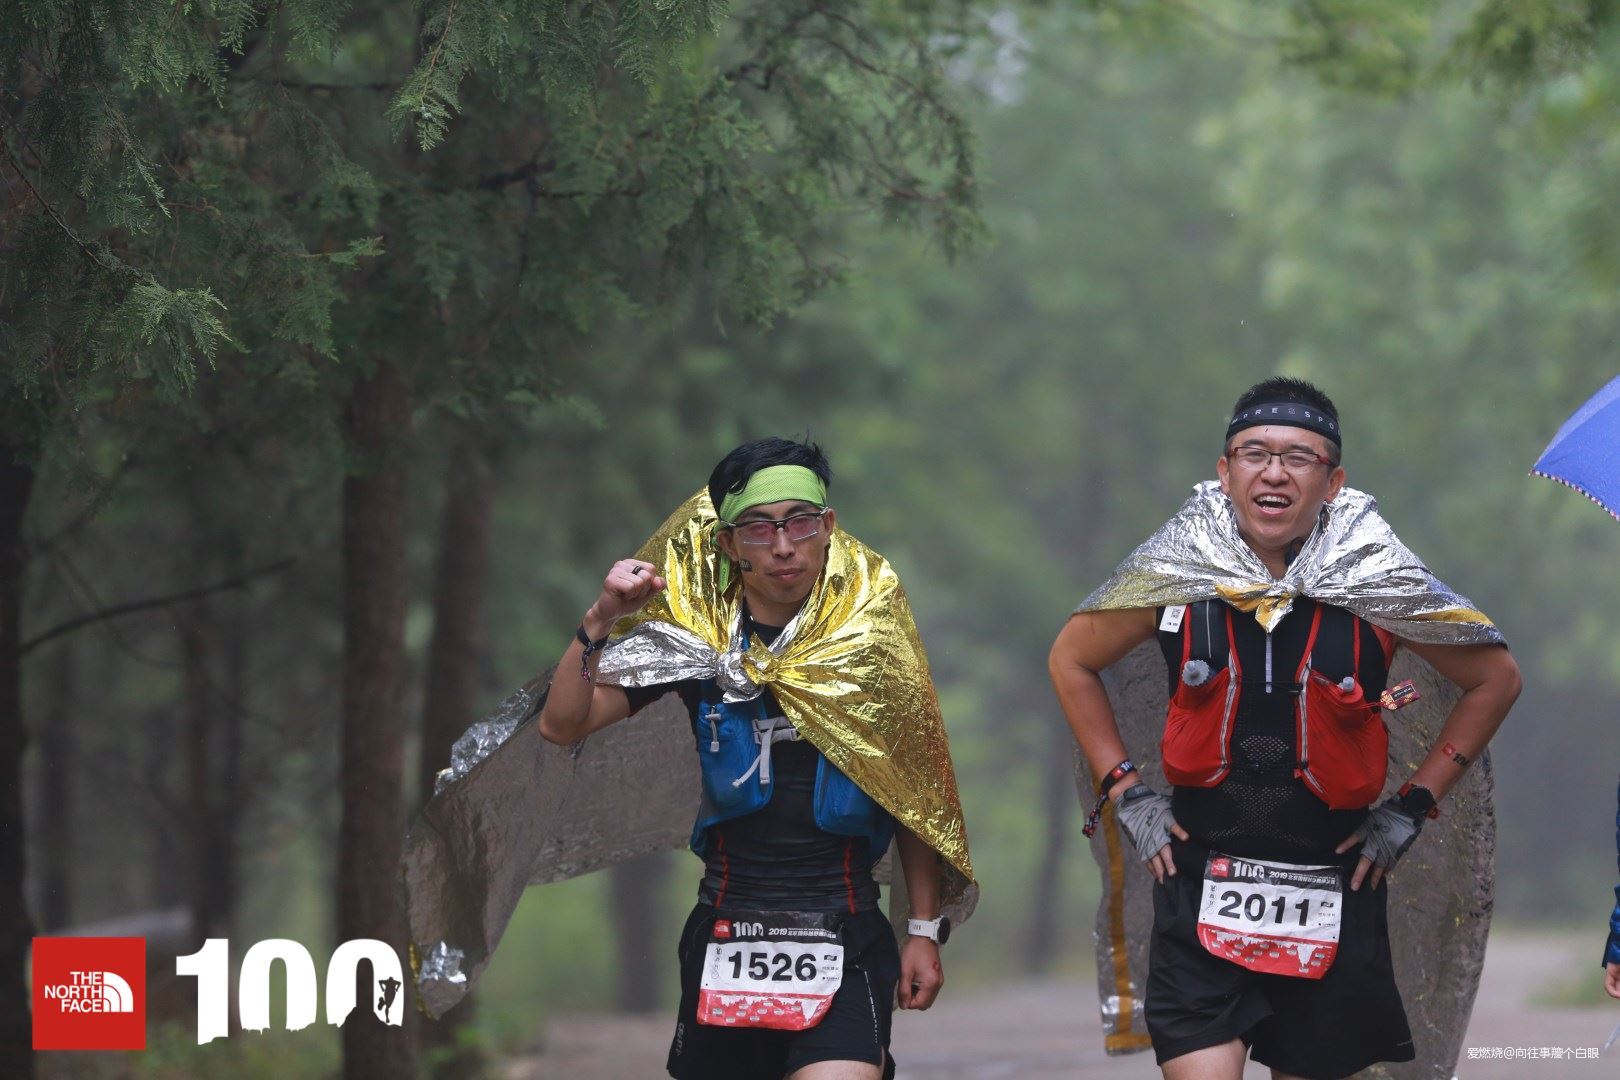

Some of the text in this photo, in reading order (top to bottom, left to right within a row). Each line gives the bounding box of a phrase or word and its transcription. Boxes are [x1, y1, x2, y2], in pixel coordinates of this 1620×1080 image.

[1232, 861, 1265, 879] 100
[1269, 870, 1288, 879] 2019
[1217, 890, 1310, 927] 2011
[732, 920, 764, 937] 100
[768, 927, 788, 936] 2019
[728, 950, 817, 982] 1526
